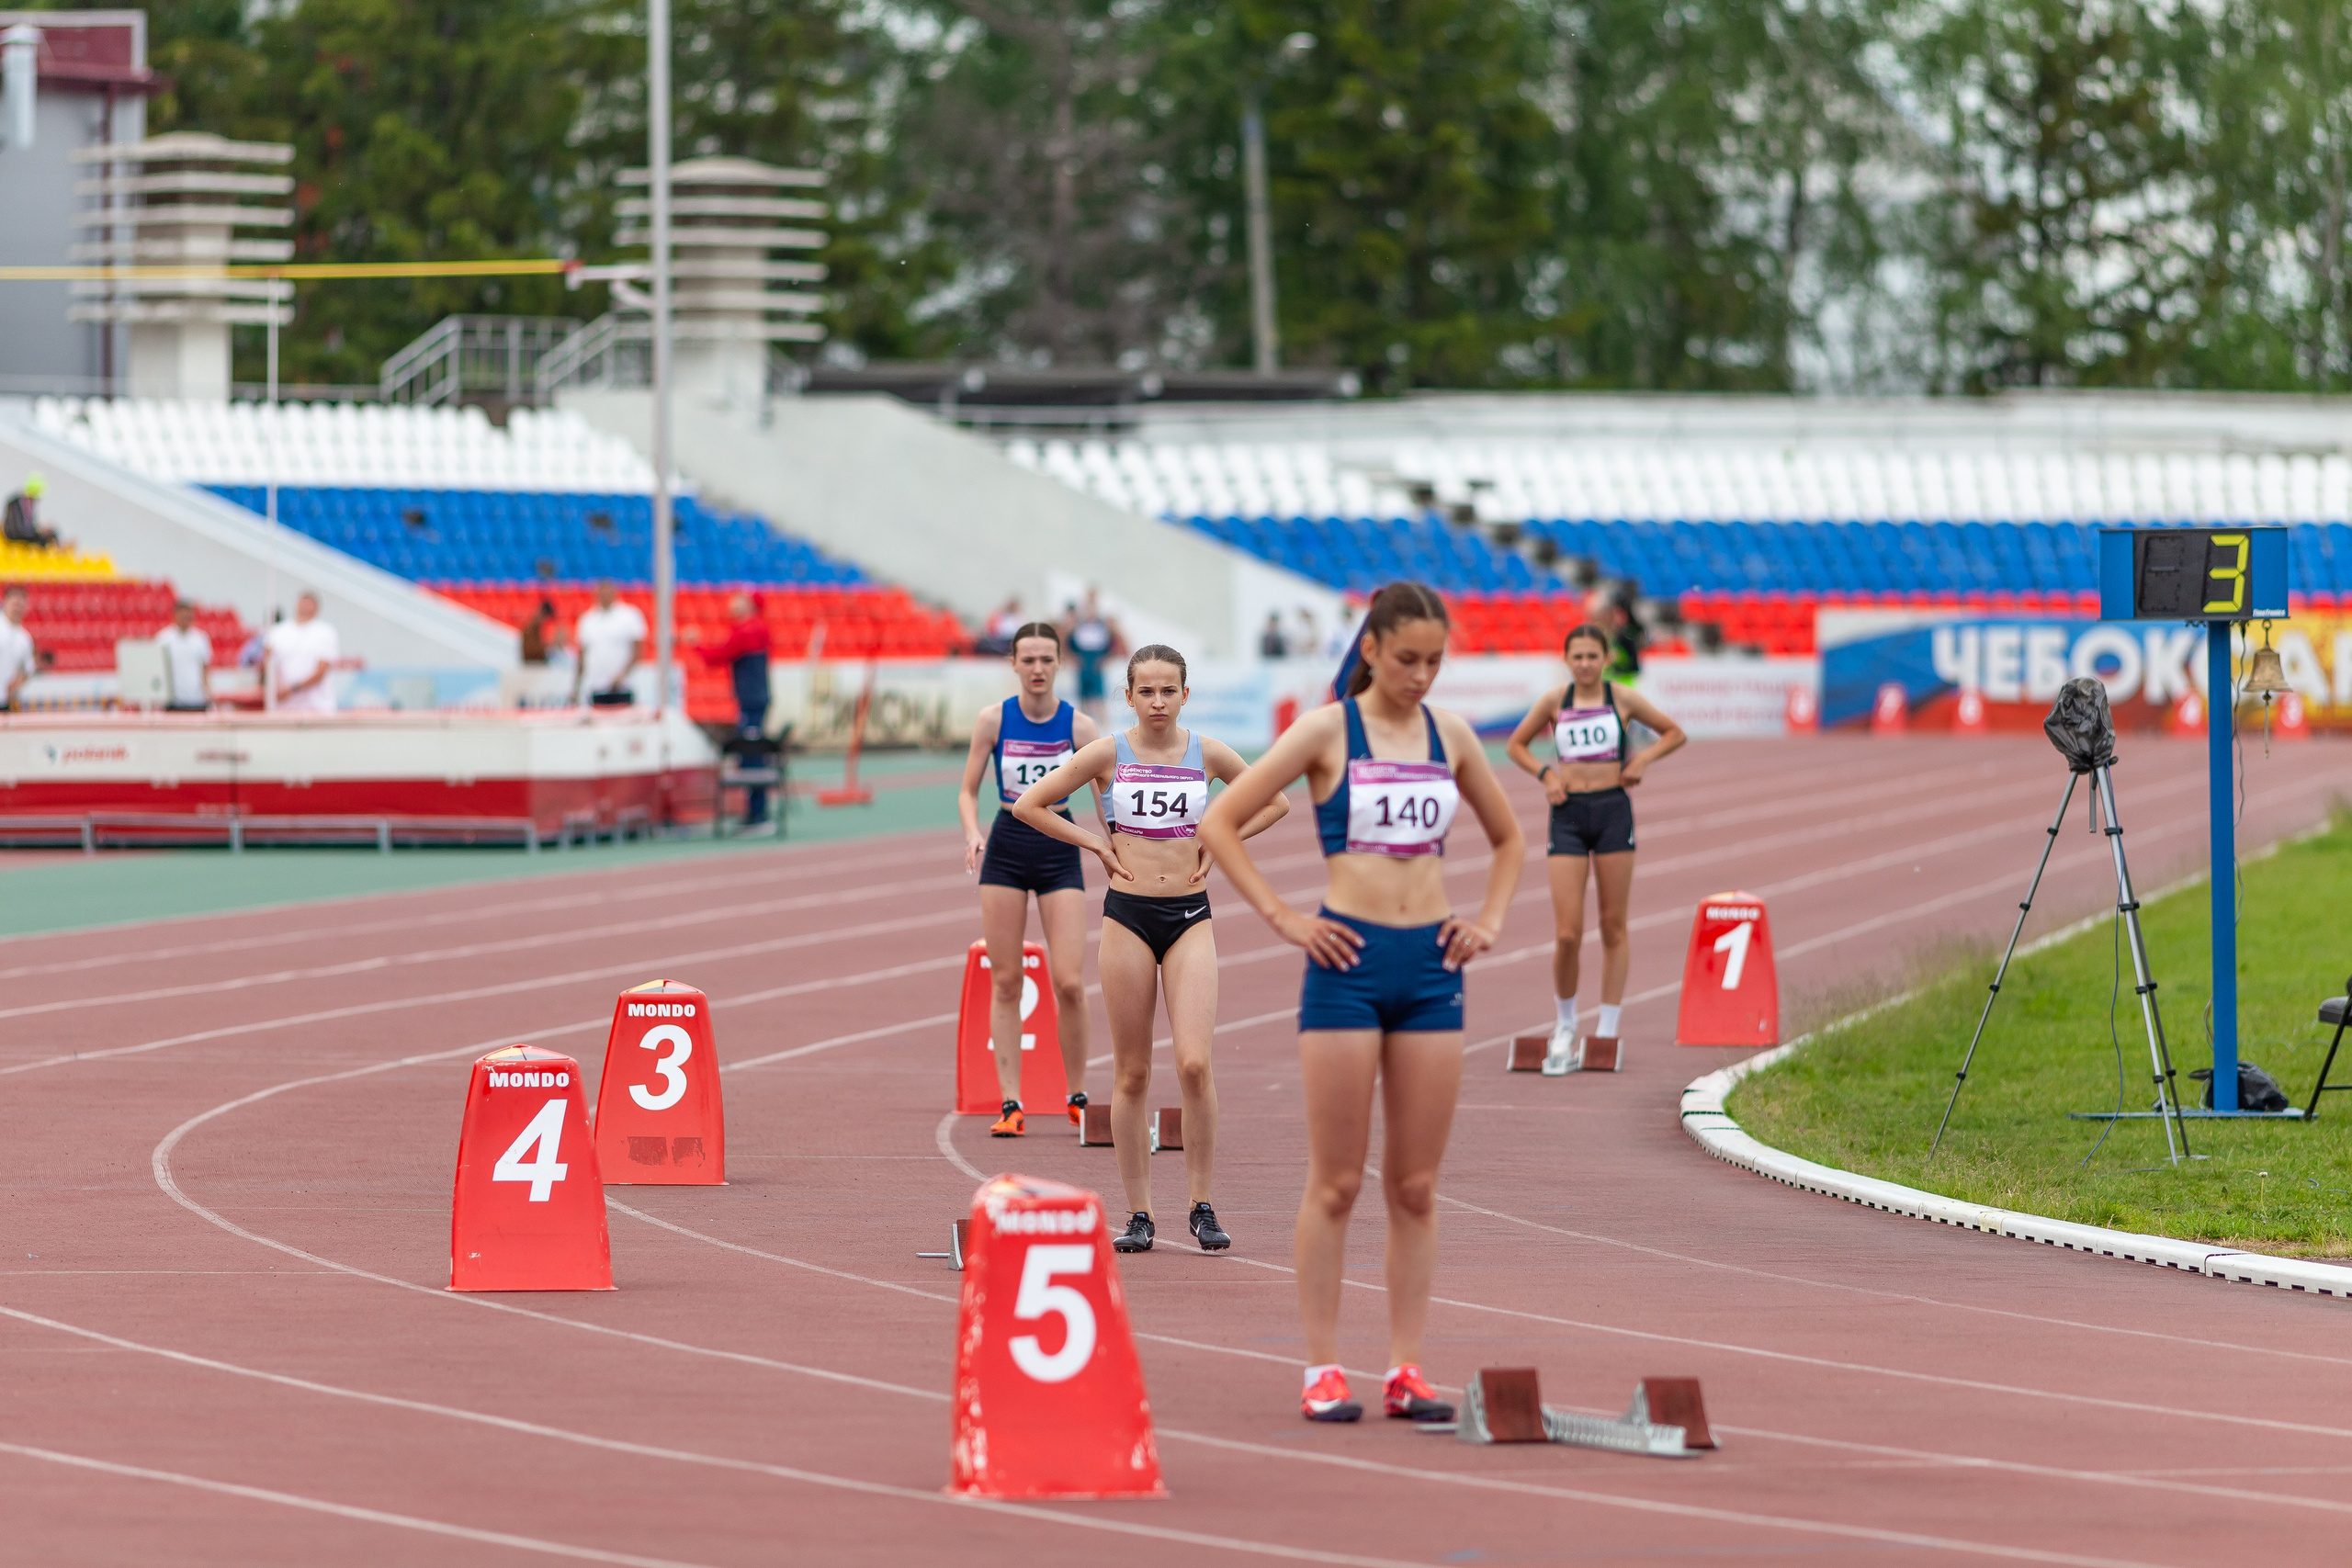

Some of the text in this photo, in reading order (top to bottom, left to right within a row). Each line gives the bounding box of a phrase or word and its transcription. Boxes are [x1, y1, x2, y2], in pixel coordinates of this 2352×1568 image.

[2202, 535, 2249, 613] 3
[1567, 726, 1607, 746] 110
[1016, 763, 1060, 784] 13
[1131, 789, 1188, 818] 154
[1375, 795, 1439, 829] 140
[1706, 907, 1760, 920] MONDO
[979, 955, 1040, 968] MDO
[1713, 921, 1753, 989] 1
[628, 1003, 695, 1017] MONDO
[489, 1072, 570, 1088] MONDO
[628, 1024, 693, 1111] 3
[492, 1099, 569, 1201] 4
[996, 1210, 1097, 1234] MONDO
[1008, 1245, 1097, 1383] 5
